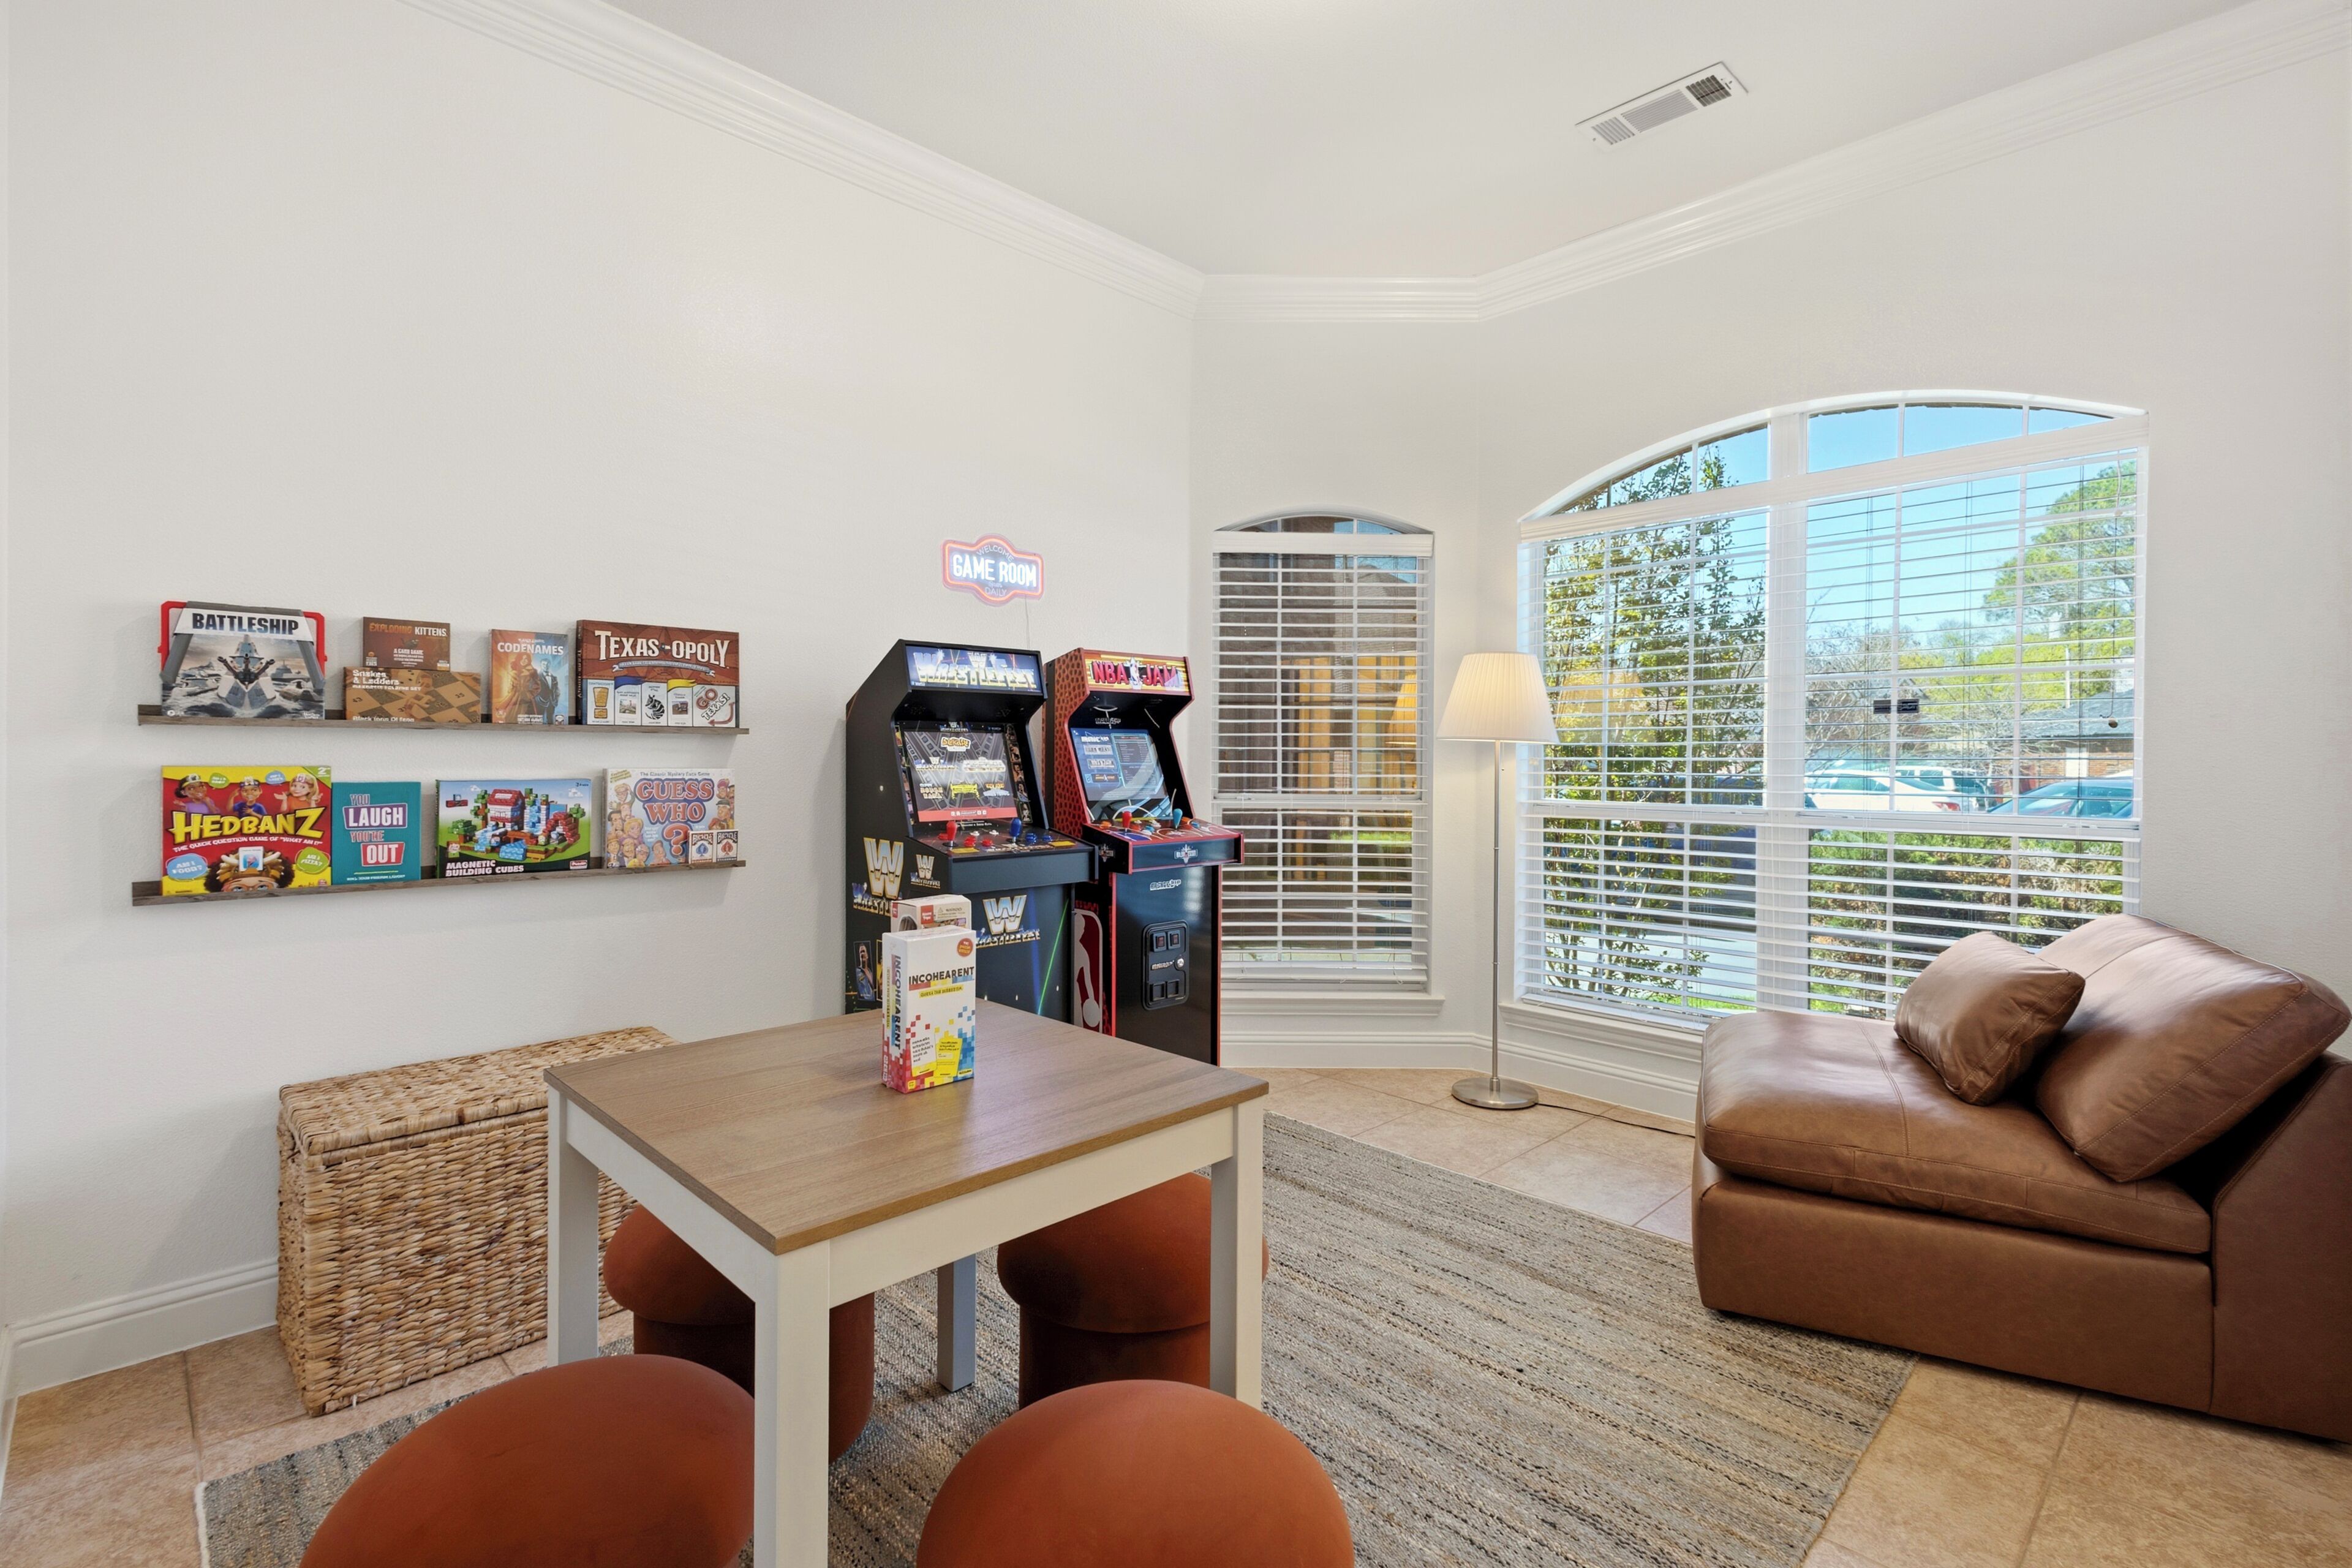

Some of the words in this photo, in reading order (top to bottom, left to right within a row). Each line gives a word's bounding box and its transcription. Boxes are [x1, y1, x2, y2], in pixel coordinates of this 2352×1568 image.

[976, 545, 1014, 562] WELCOME
[953, 554, 996, 581] GAME
[999, 560, 1037, 587] ROOM
[985, 587, 1007, 597] DAILY
[192, 612, 298, 635] BATTLESHIP
[369, 622, 412, 634] EXPLODING
[415, 627, 448, 637] KITTENS
[497, 642, 564, 656] CODENAMES
[1092, 660, 1129, 685] NBA
[350, 794, 370, 805] YOU
[635, 780, 715, 801] GUESS
[349, 807, 404, 827] LAUGH
[645, 802, 705, 823] WHO
[167, 807, 326, 845] HEDBANZ
[366, 844, 399, 864] OUT
[445, 867, 492, 877] BUILDING
[496, 865, 524, 873] CUBES
[446, 860, 496, 870] MAGNETIC
[908, 967, 974, 986] INCOHEARENT
